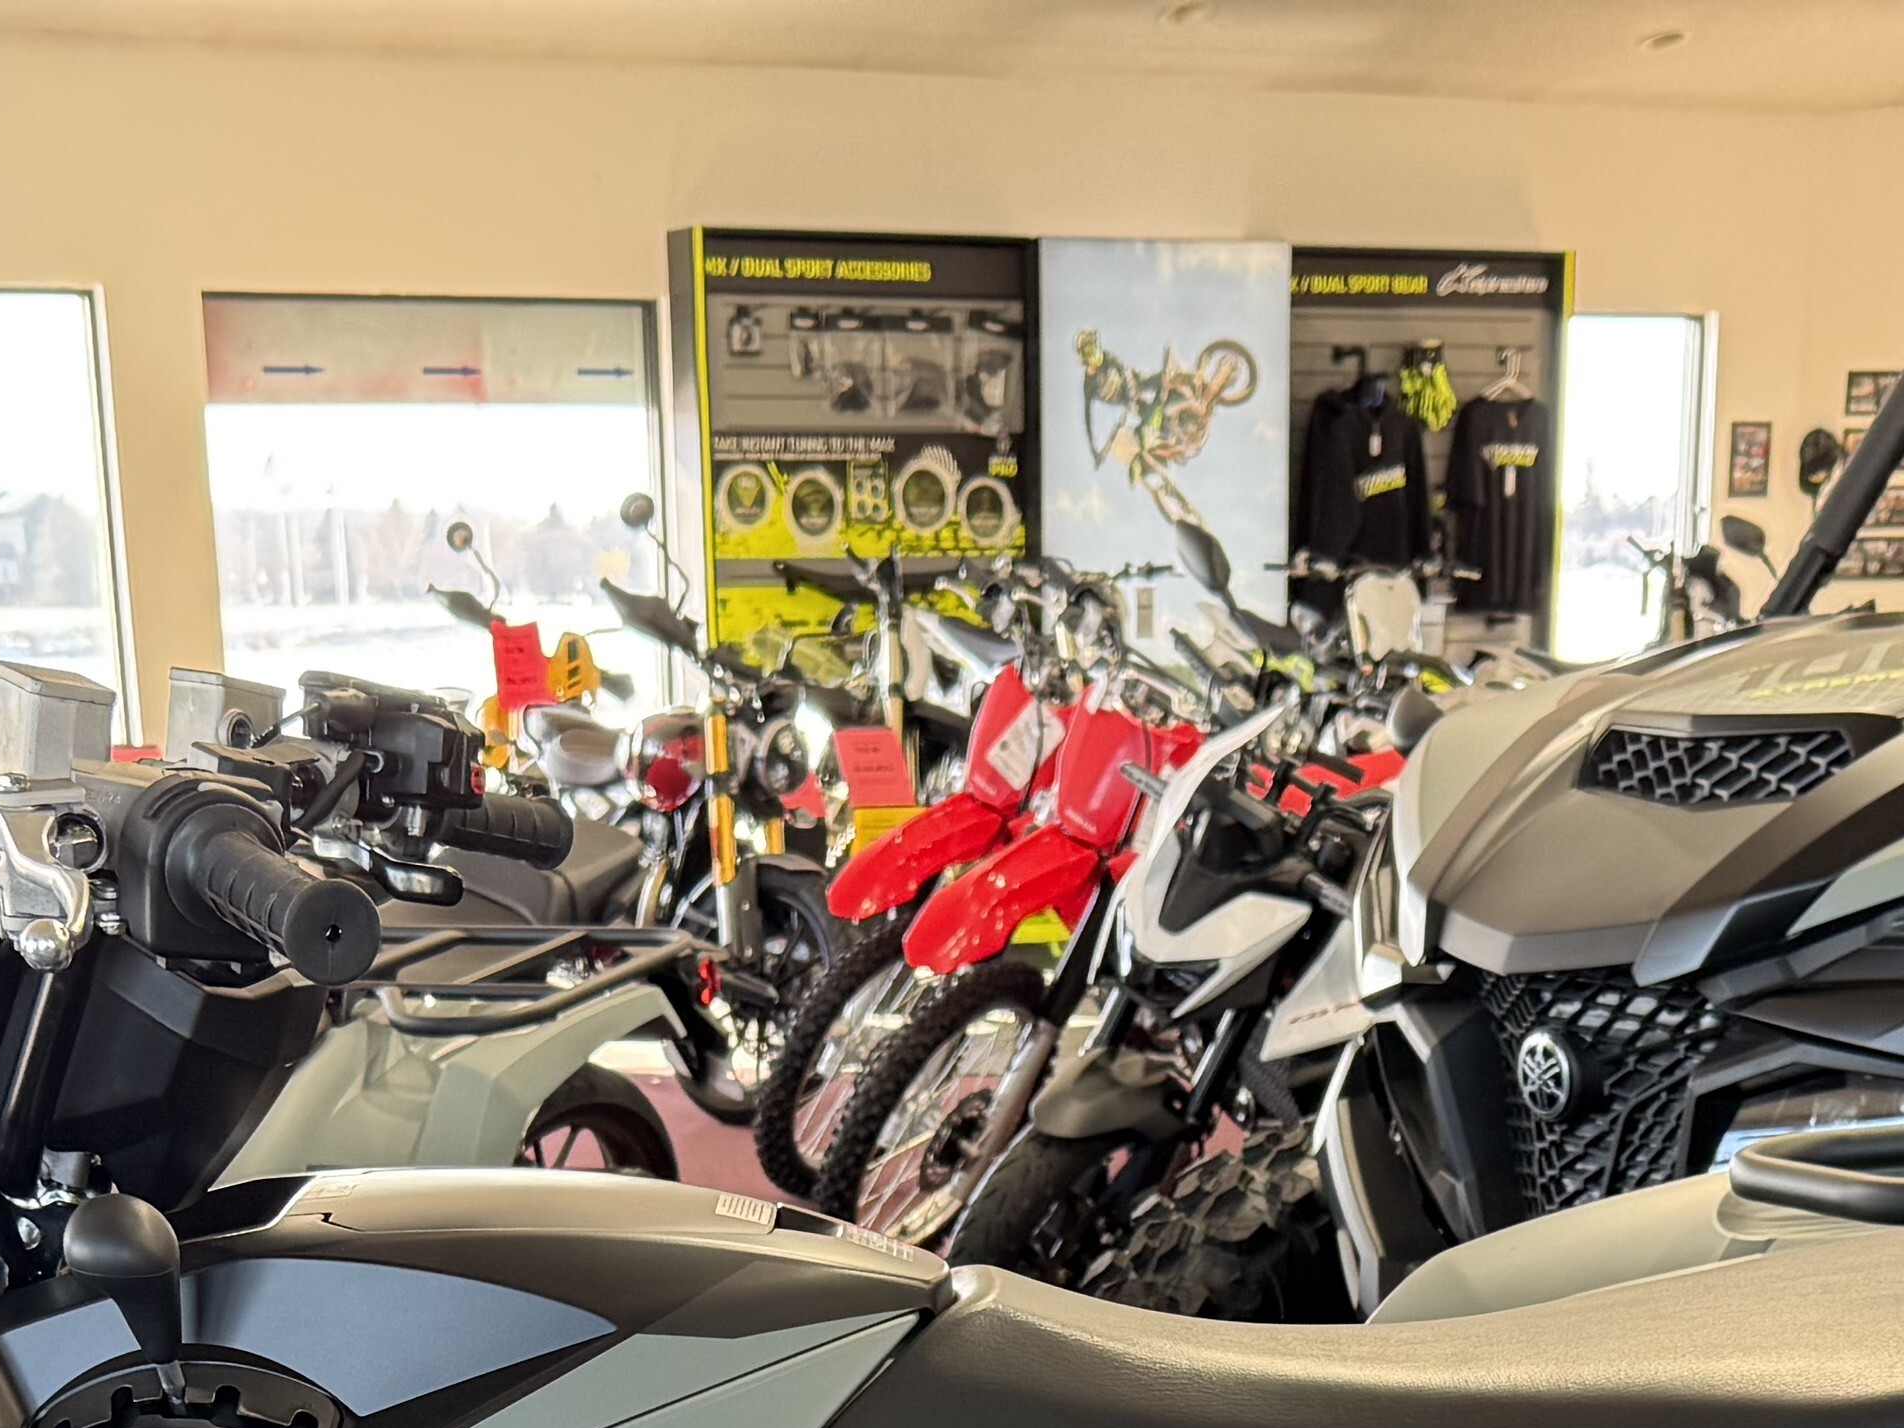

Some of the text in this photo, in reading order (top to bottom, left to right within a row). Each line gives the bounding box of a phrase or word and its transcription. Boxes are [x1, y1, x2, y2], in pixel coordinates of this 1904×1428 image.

[741, 257, 783, 278] DUAL
[784, 258, 834, 279] SPORT
[836, 260, 933, 282] ACCESSORIES
